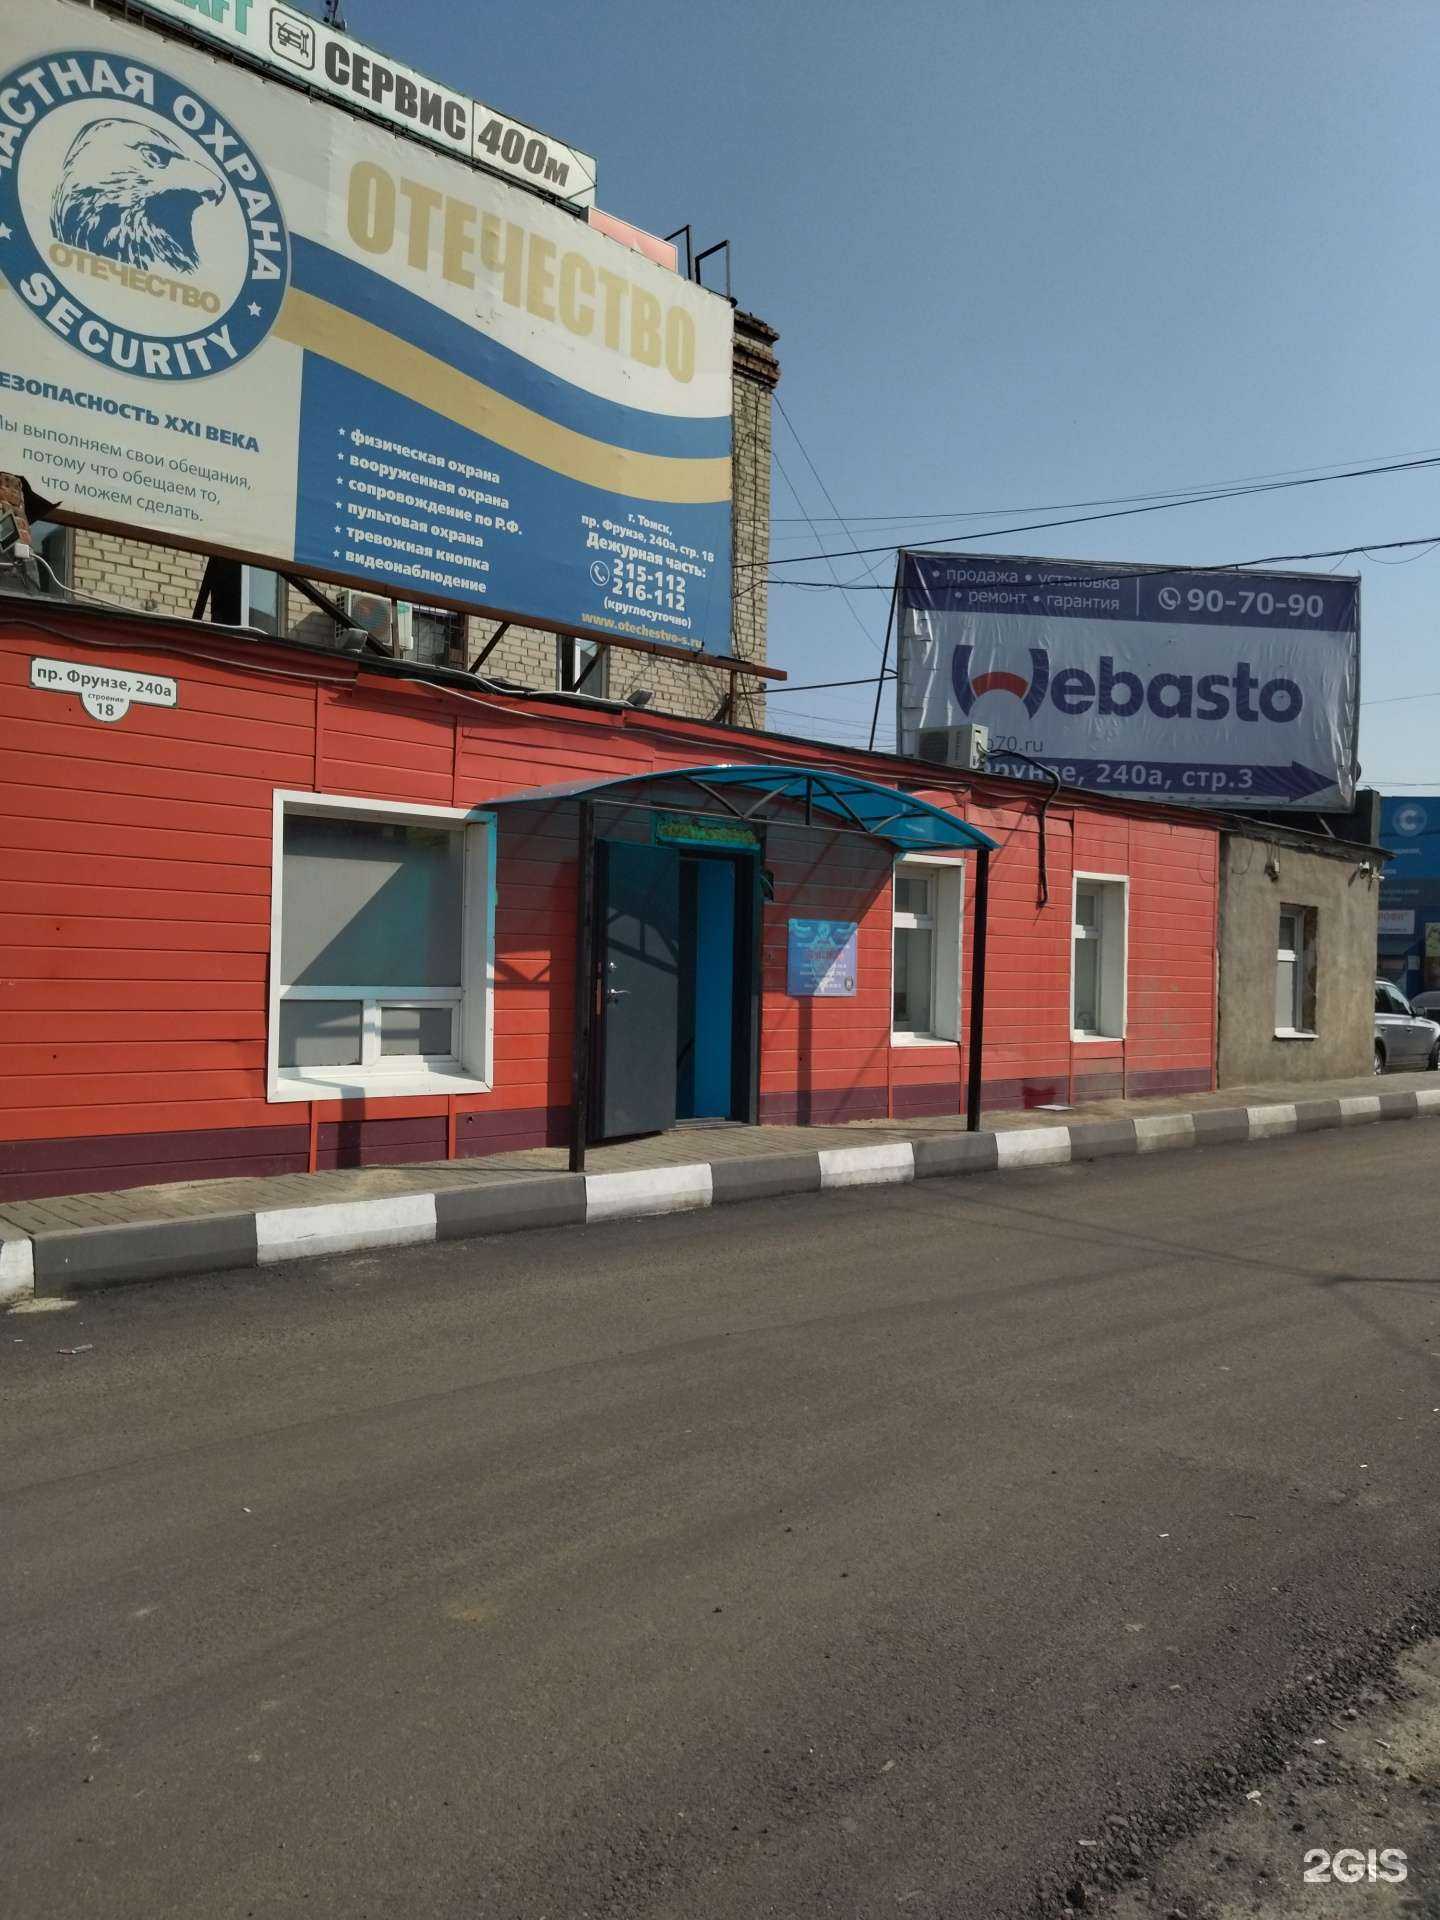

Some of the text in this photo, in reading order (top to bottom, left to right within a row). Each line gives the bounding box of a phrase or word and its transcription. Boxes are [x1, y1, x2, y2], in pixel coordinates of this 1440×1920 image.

[325, 41, 466, 140] СЕРВИС
[0, 57, 282, 281] АСТНАЯ ОХРАНА
[50, 242, 222, 315] ОТЕЧЕСТВО
[347, 160, 696, 384] ОТЕЧЕСТВО
[20, 271, 239, 376] SECURITY
[0, 371, 159, 426] ЕЗОПАСНОСТЬ
[205, 425, 260, 452] ВЕКА
[23, 424, 122, 459] выполняем
[126, 448, 165, 468] свои
[168, 457, 254, 491] обещания,
[23, 448, 221, 505] потому что обещаем то,
[350, 429, 500, 484] физическая охрана
[41, 474, 205, 522] что можем сделать.
[348, 479, 473, 521] сопровождение
[474, 512, 493, 527] по
[349, 455, 509, 509] вооруженная охрана
[347, 502, 484, 548] пультовая охрана
[581, 515, 715, 563] пр. Фрунзе, 240а, стр. 18
[638, 514, 673, 537] Томск,
[345, 550, 487, 593] видеонаблюдение
[346, 526, 490, 572] тревожная кнопка
[586, 532, 707, 579] Дежурная часть:
[612, 578, 685, 612] 216-112
[613, 558, 686, 594] 215-112
[946, 568, 1120, 590] продажа установка
[603, 596, 692, 630] (круглосуточно)
[968, 591, 1120, 611] ремонт гарантия
[1187, 589, 1324, 618] 90-70-90
[37, 667, 172, 697] пр. Фрунзе, 240а
[87, 692, 125, 703] строение
[952, 644, 1303, 723] Webasto
[96, 703, 115, 717] 18
[1096, 763, 1171, 790] 240а,
[1182, 769, 1253, 792] стр.3
